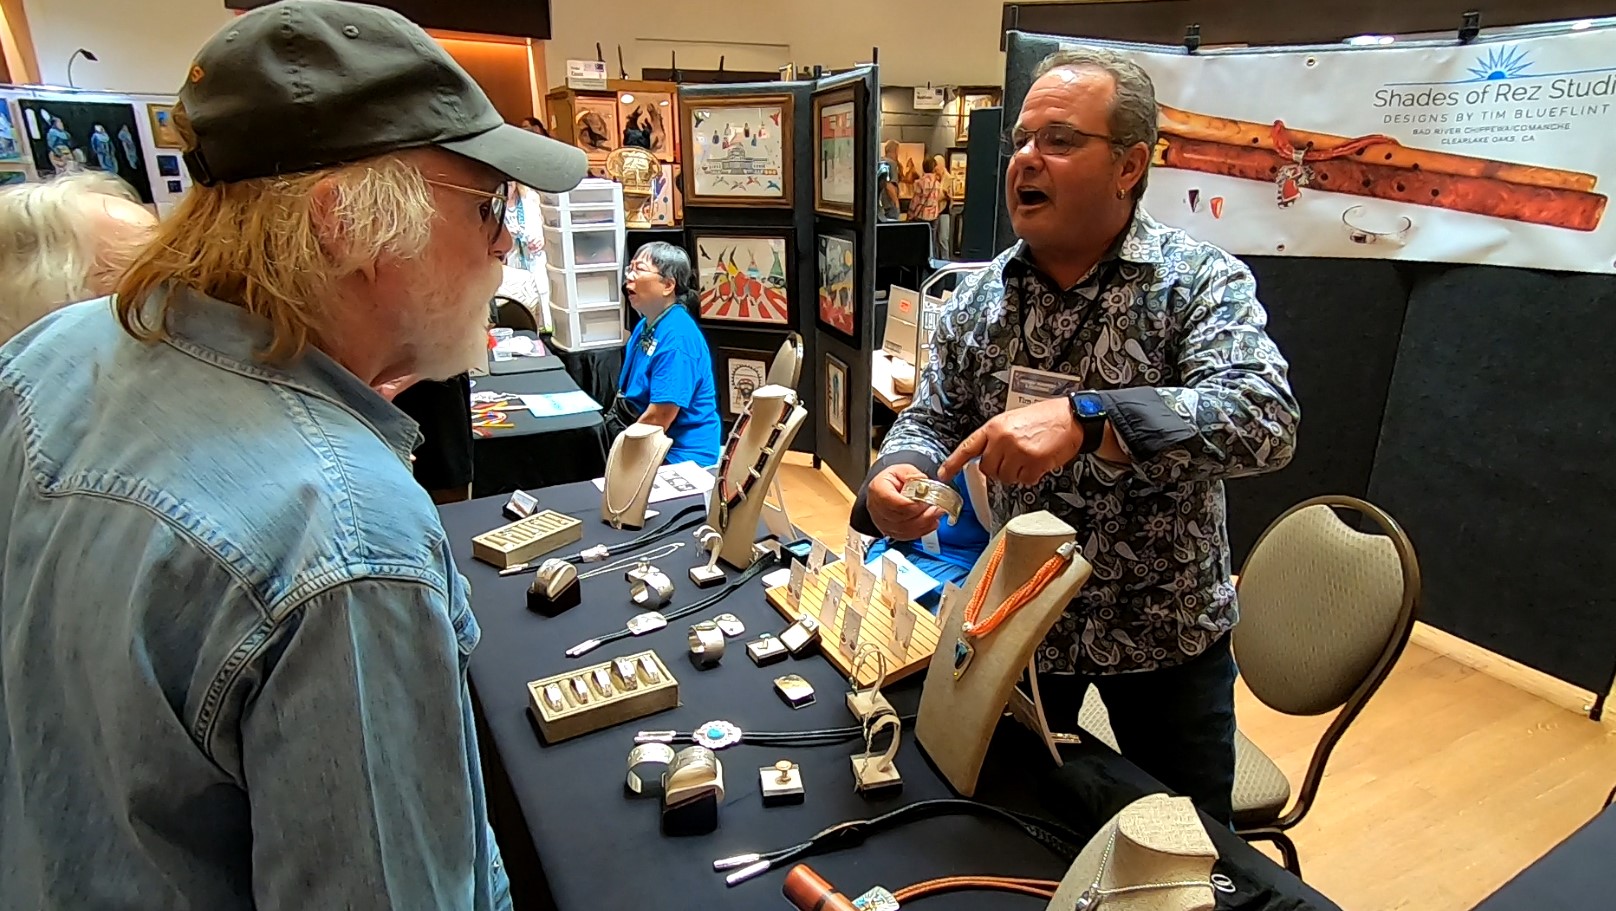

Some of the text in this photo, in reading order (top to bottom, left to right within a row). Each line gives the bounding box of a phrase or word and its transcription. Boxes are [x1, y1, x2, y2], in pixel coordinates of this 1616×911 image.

[1373, 87, 1460, 108] Shades
[1466, 84, 1492, 105] of
[1494, 82, 1543, 103] Rez
[1383, 103, 1611, 124] DESIGNS BY TIM BLUEFLINT
[1434, 127, 1461, 135] RIVER
[1441, 136, 1489, 145] CLEARLAKE
